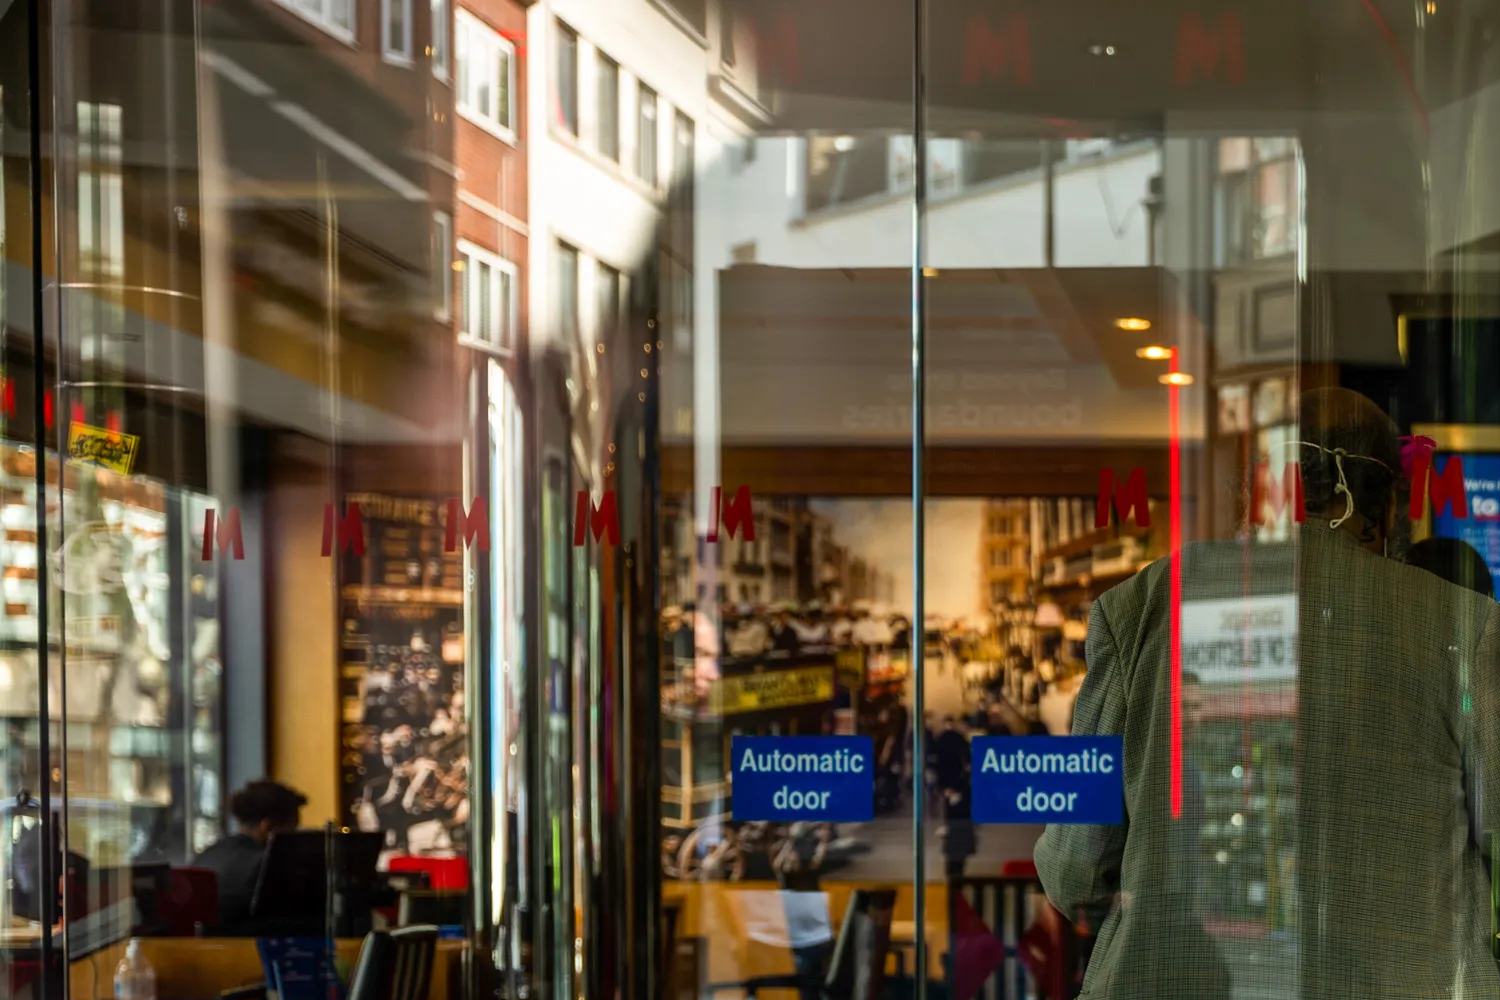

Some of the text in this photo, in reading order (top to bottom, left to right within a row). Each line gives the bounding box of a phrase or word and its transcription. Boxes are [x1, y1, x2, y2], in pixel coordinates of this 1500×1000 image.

[1472, 495, 1500, 516] to
[740, 748, 864, 773] Automatic
[981, 748, 1114, 773] Automatic
[773, 786, 830, 810] door
[1016, 786, 1077, 812] door
